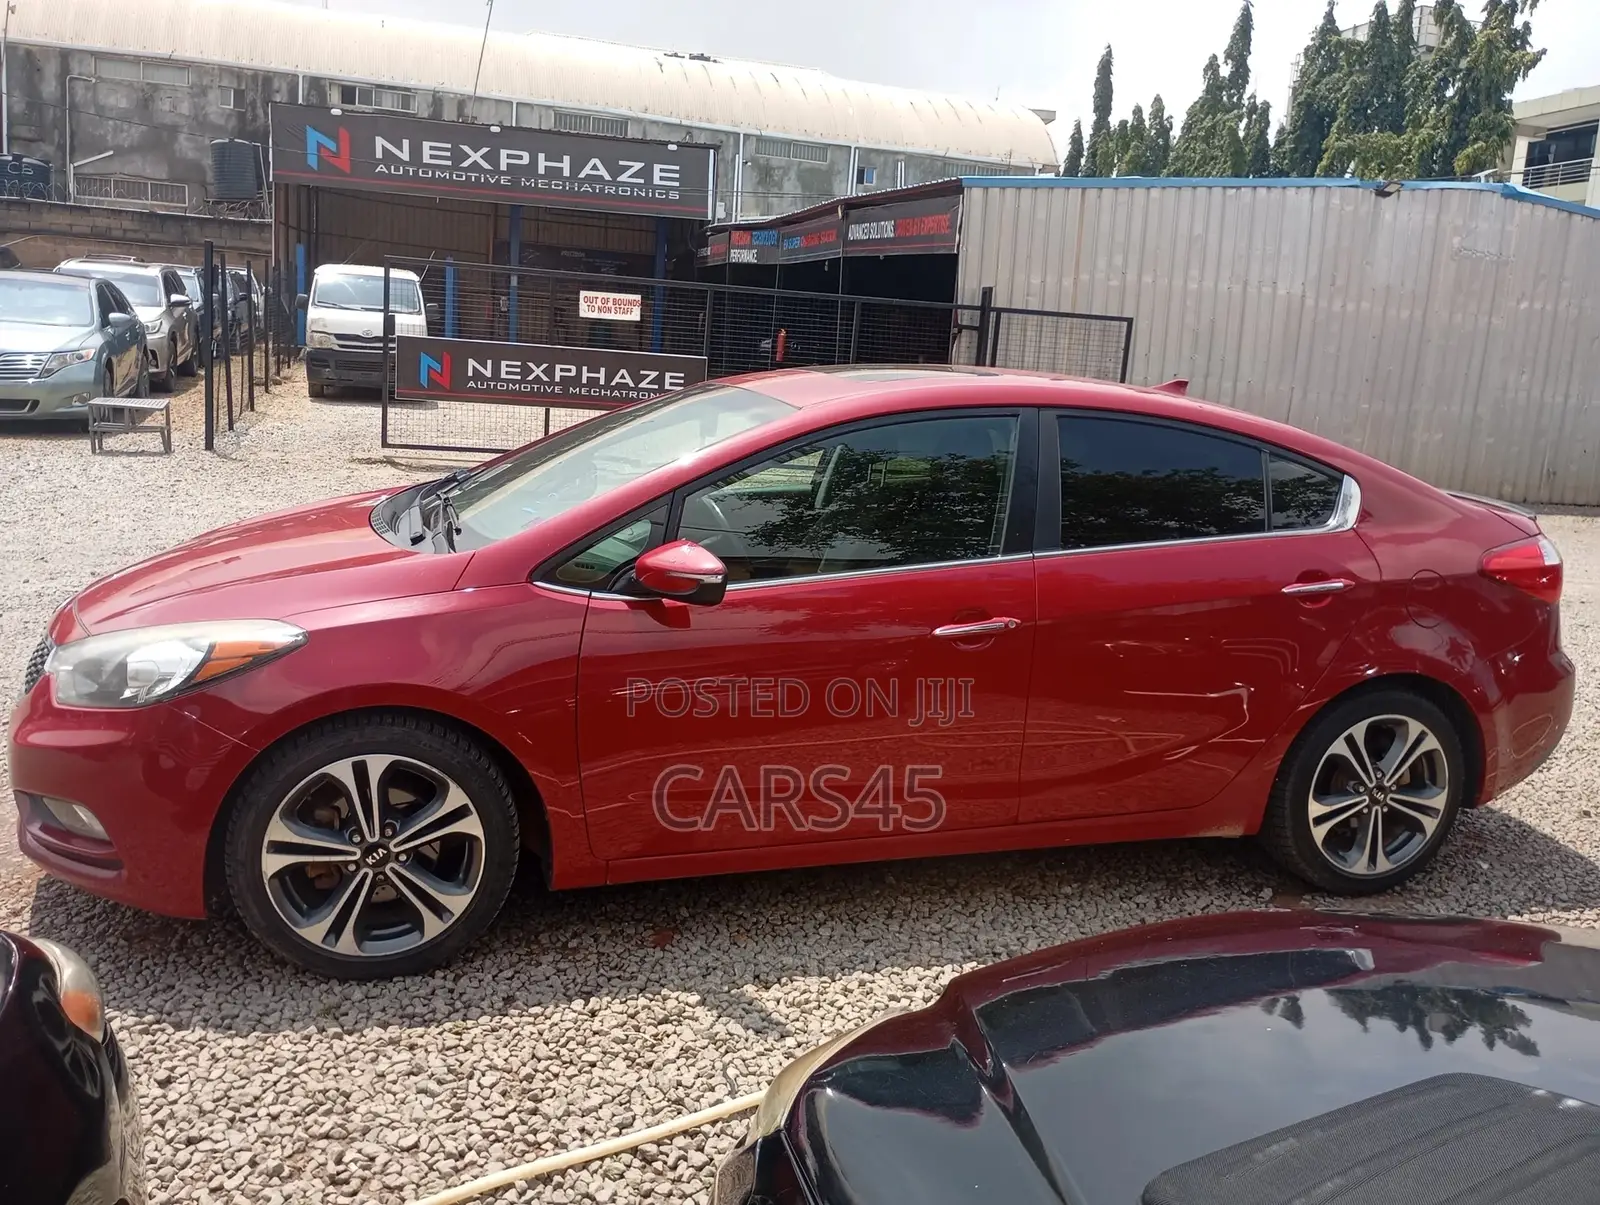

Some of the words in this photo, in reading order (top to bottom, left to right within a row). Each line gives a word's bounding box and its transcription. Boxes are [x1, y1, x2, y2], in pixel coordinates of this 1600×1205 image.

[374, 135, 681, 187] NEXPHAZE
[374, 163, 512, 186] AUTOMOTIVE
[520, 177, 680, 200] MECHATRONICS
[730, 248, 758, 263] PERFORMANCE
[583, 295, 599, 304] OUT
[600, 297, 610, 306] OF
[612, 297, 641, 308] BOUNDS
[586, 304, 596, 313] TO
[597, 305, 612, 314] NON
[613, 306, 634, 315] STAFF
[467, 358, 685, 390] NEXPHAZE
[466, 380, 563, 395] AUTOMOTIVE
[569, 386, 660, 399] MECHATRON
[1371, 787, 1385, 802] KIA
[365, 847, 388, 865] KIA
